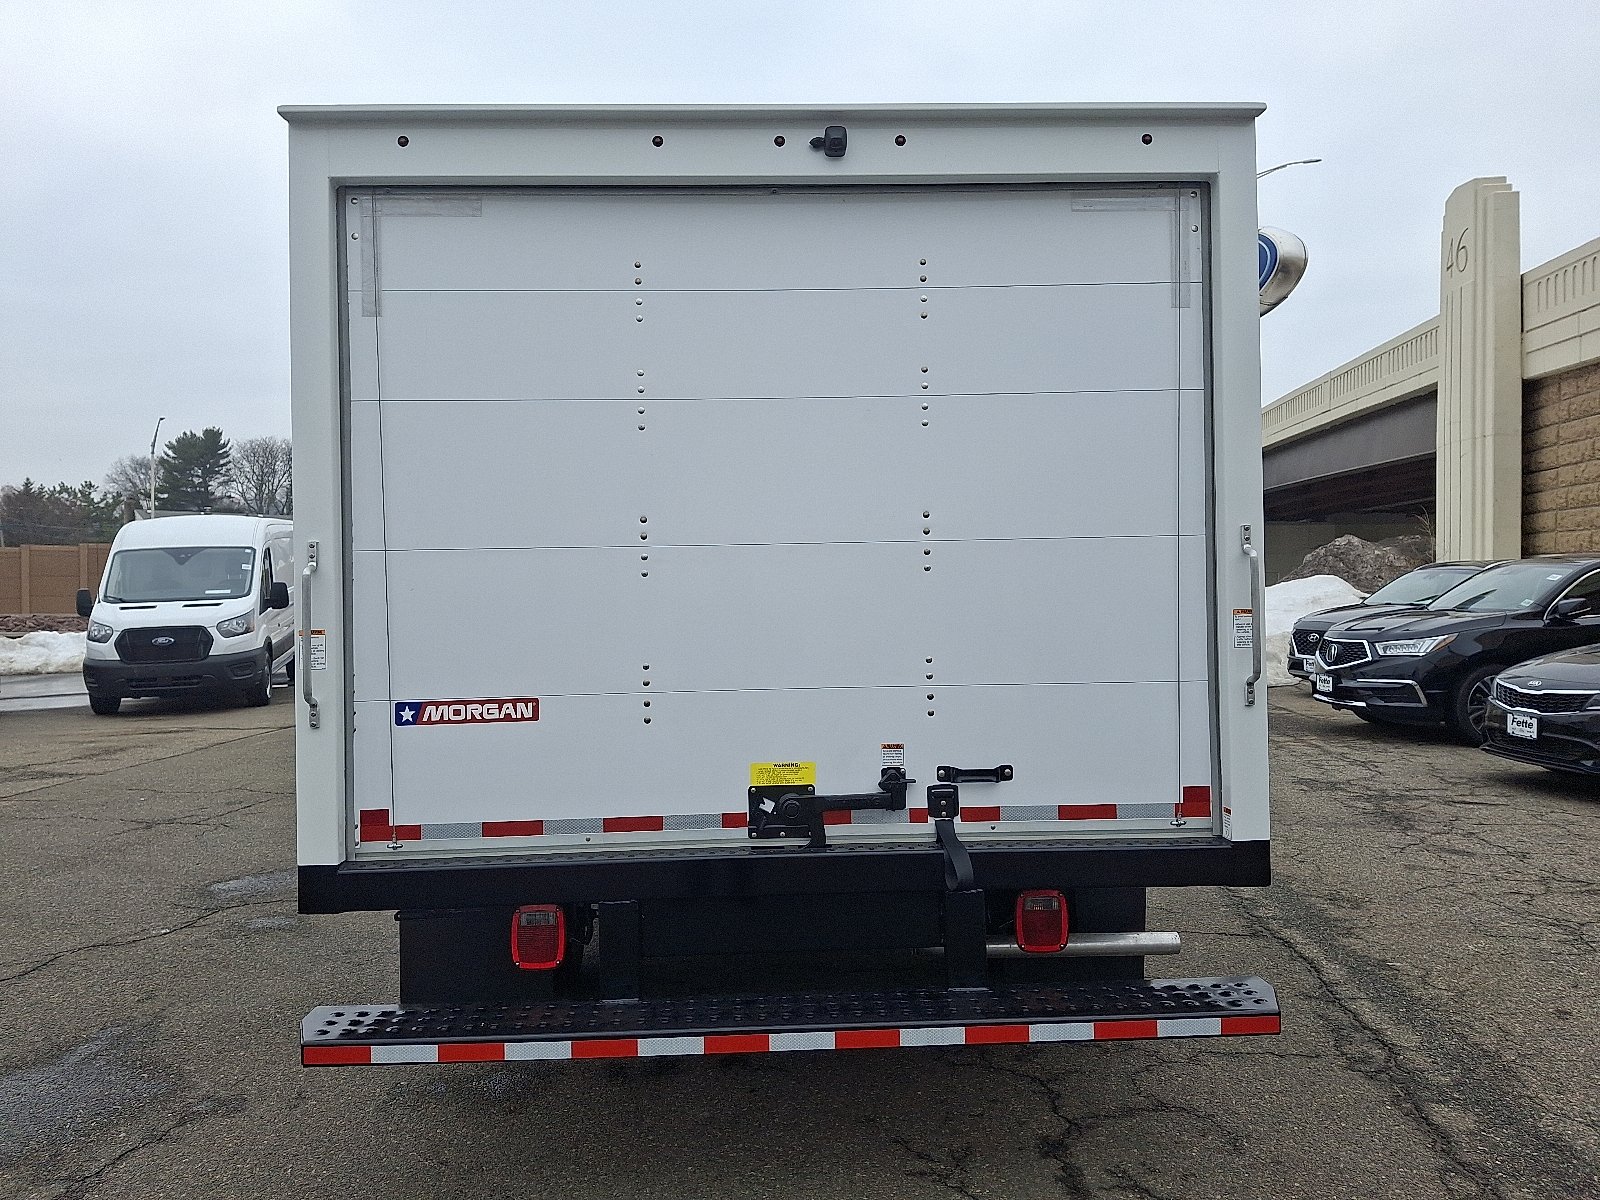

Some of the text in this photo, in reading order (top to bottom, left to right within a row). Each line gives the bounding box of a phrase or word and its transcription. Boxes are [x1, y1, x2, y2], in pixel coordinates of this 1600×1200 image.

[1446, 227, 1469, 278] 46
[422, 702, 533, 722] MORGAN
[1511, 716, 1534, 730] Fette
